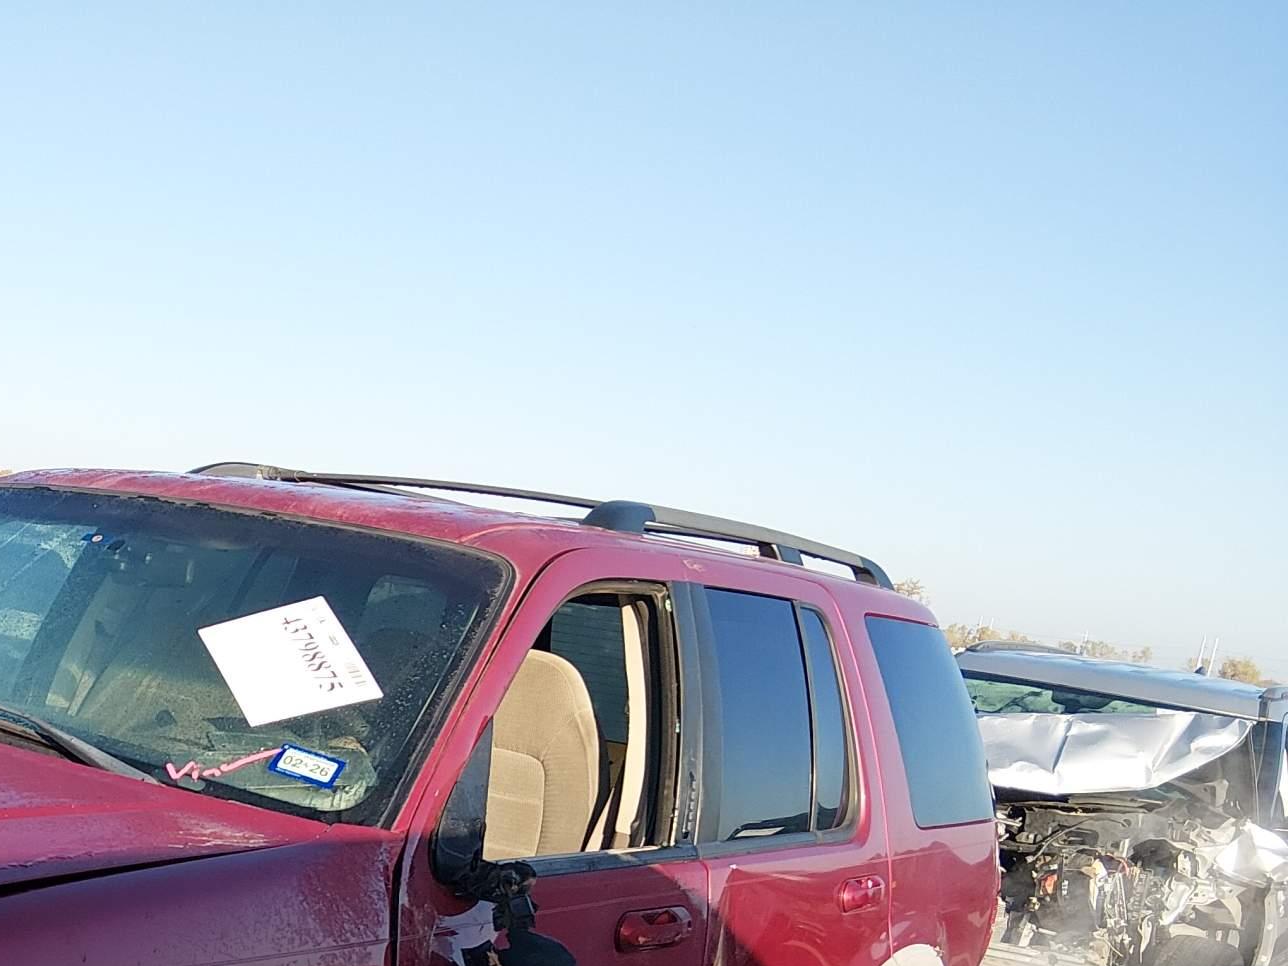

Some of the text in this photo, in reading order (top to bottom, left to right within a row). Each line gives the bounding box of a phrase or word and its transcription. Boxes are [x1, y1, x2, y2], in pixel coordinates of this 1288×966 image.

[281, 617, 344, 692] 43798875
[282, 755, 304, 769] 02
[308, 763, 331, 777] 26
